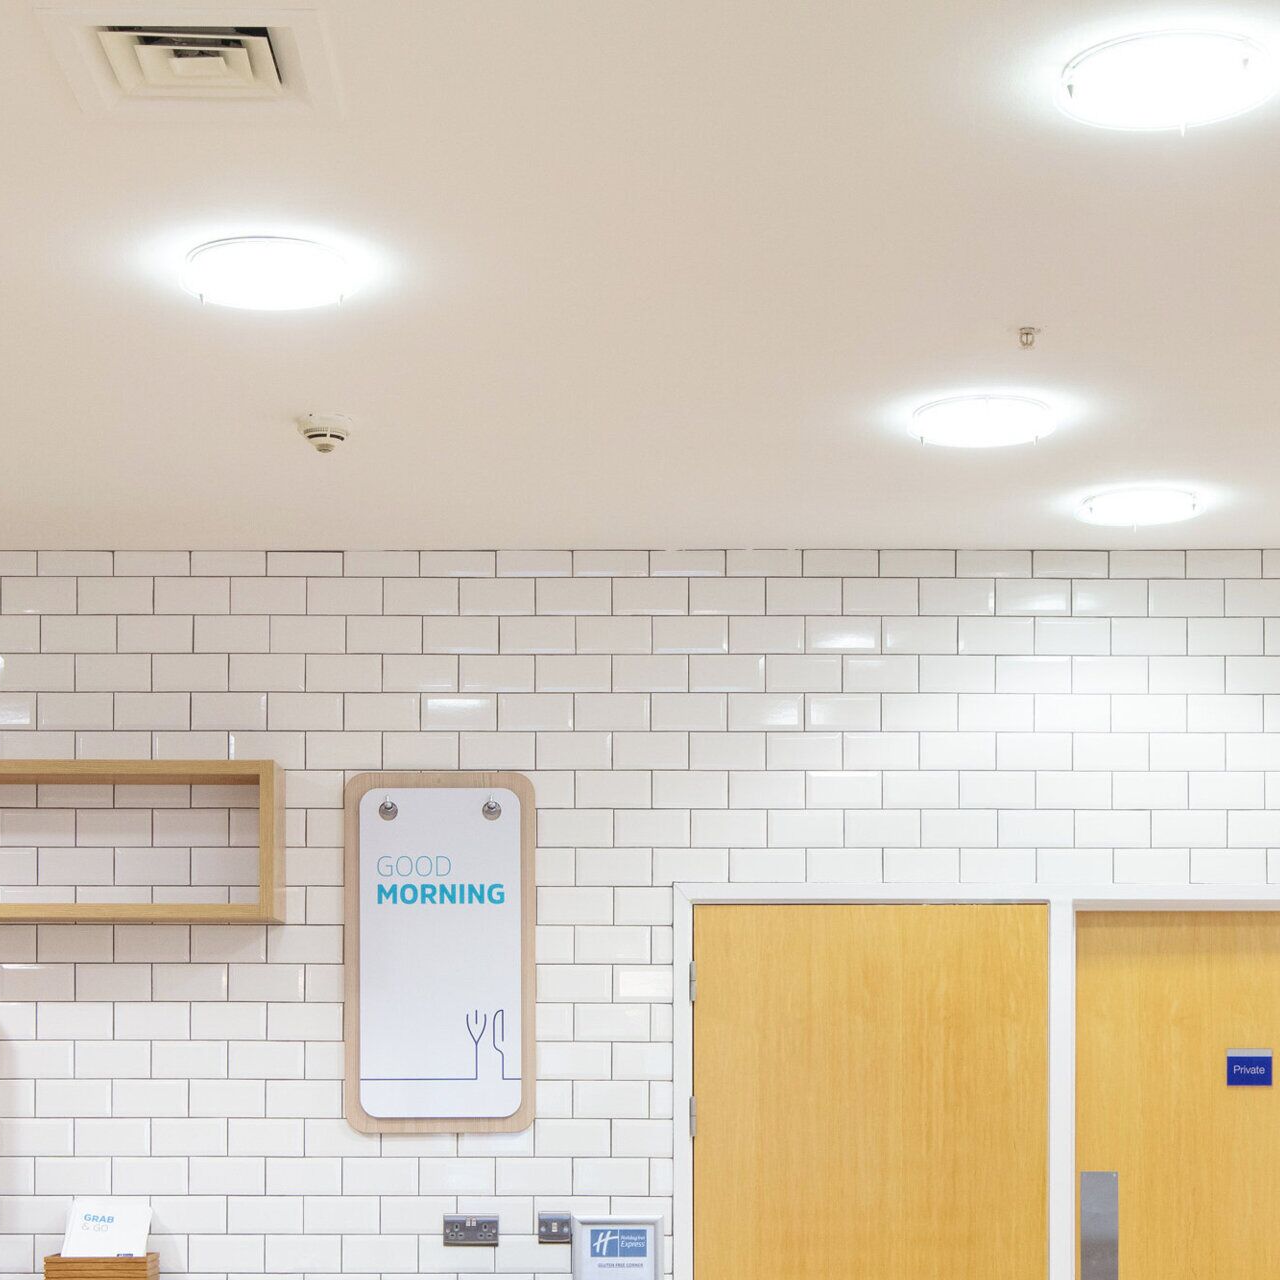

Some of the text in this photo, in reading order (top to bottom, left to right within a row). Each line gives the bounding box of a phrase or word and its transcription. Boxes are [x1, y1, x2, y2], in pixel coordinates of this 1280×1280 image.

[377, 855, 452, 877] GOOD
[377, 883, 505, 905] MORNING
[1233, 1065, 1265, 1075] Private
[83, 1213, 115, 1224] GRAB
[93, 1224, 109, 1232] GO
[621, 1241, 646, 1249] Express
